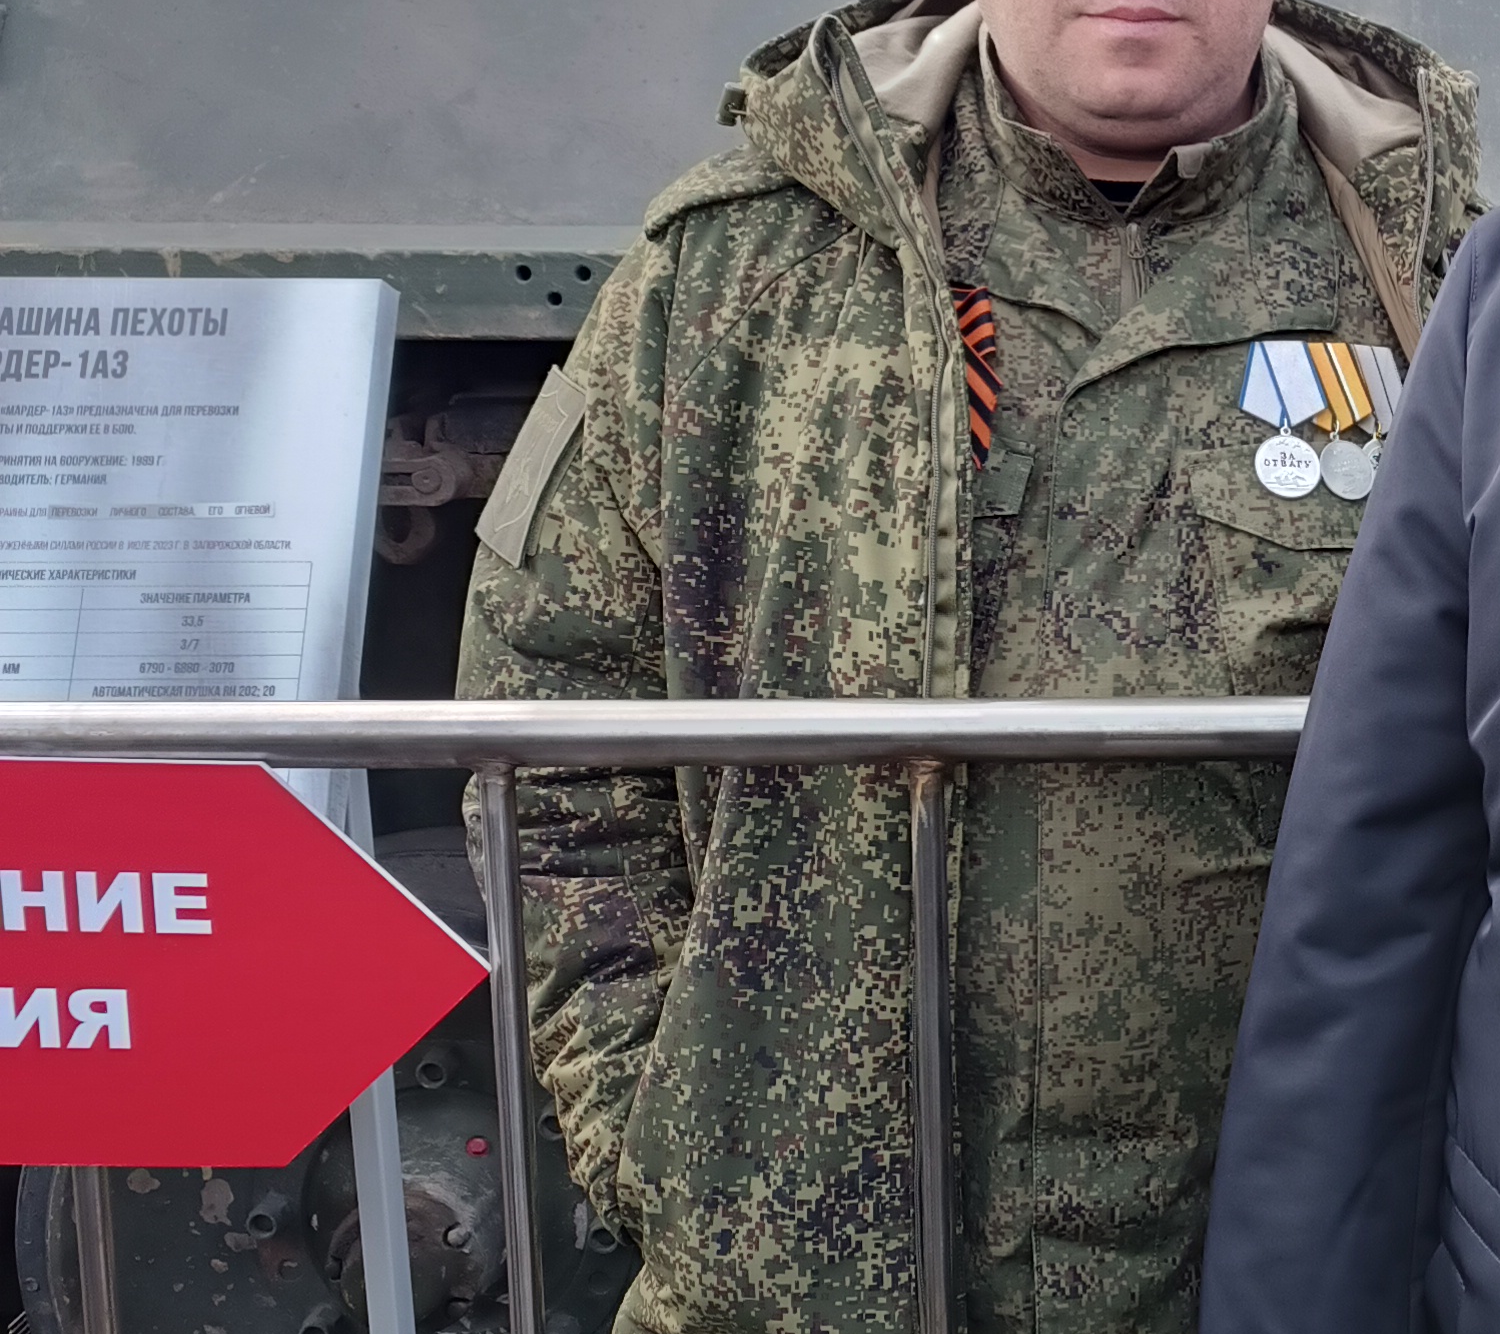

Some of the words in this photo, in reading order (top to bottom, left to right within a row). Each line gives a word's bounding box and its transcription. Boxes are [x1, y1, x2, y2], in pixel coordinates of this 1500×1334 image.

[0, 307, 100, 336] АШИНА
[110, 307, 228, 336] ПЕХОТЫ
[0, 350, 129, 382] ДЕР-1А3
[76, 405, 159, 417] ПРЕДНАЗНАЧЕНА
[161, 405, 182, 417] ДЛЯ
[184, 405, 239, 416] ПЕРЕВОЗКИ
[16, 423, 23, 435] И
[25, 423, 87, 435] ПОДДЕРЖКИ
[89, 423, 101, 434] ЕЕ
[103, 423, 110, 434] В
[112, 423, 137, 435] БОЮ.
[44, 455, 57, 466] НА
[1280, 451, 1296, 460] ЗА
[1263, 458, 1312, 468] ОТВАГУ
[50, 507, 98, 517] ПЕРЕВОЗКИ
[208, 506, 223, 515] ЕГО
[0, 569, 46, 580] ИЧЕСКИЕ
[48, 569, 137, 580] ХАРАКТЕРИСТИКИ
[140, 593, 191, 604] ЗНАЧЕНИЕ
[193, 593, 250, 603] ПАРАМЕТРА
[180, 639, 200, 650] 3/7
[139, 662, 165, 673] 6790
[209, 662, 235, 673] 3070
[92, 686, 183, 697] АВТОМАТИЧЕСКАЯ
[185, 686, 220, 697] ПУШКА
[0, 870, 213, 934] НИЕ
[0, 987, 132, 1050] ИЯ
